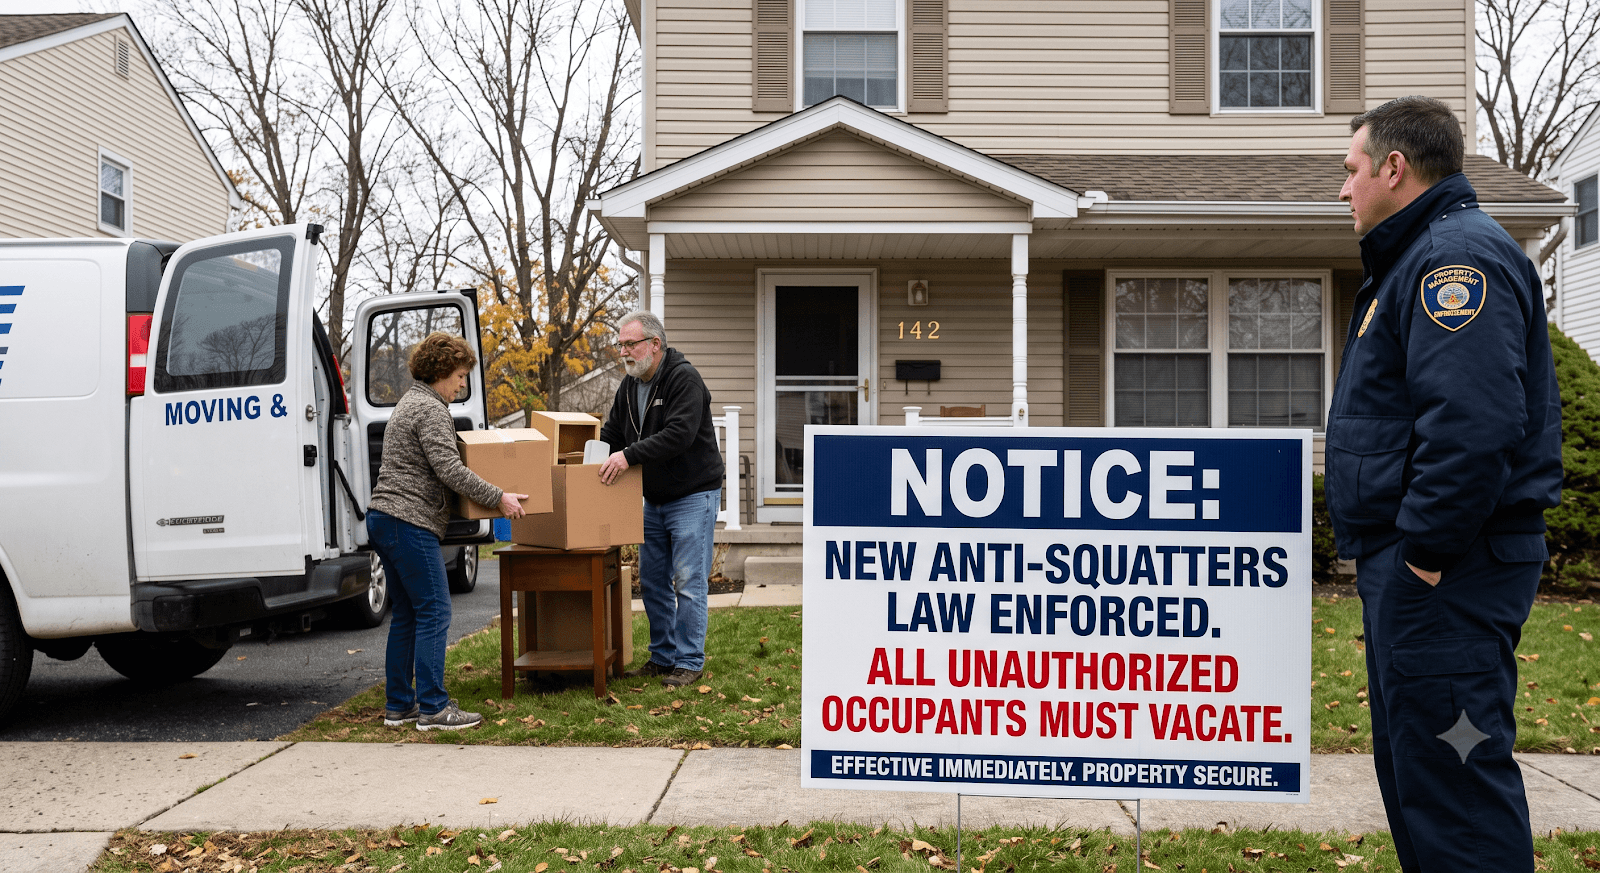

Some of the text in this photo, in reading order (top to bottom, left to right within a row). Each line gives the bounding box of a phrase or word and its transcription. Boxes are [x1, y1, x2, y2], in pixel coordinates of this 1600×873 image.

[1427, 275, 1480, 290] MANAGEMENT
[1433, 269, 1475, 280] PROPERTY
[898, 320, 940, 339] 142
[165, 393, 288, 426] MOVING &
[890, 447, 1220, 520] NOTICE:
[825, 540, 1289, 590] NEW ANTI-SQUATTERS
[887, 591, 1221, 639] LAW ENFORCED.
[866, 647, 1239, 693] ALL UNAUTHORIZED
[822, 695, 1293, 743] OCCUPANTS MUST VACATE.
[831, 755, 1279, 788] EFFECTIVE IMMEDIATELY. PROPERTY SECURE.
